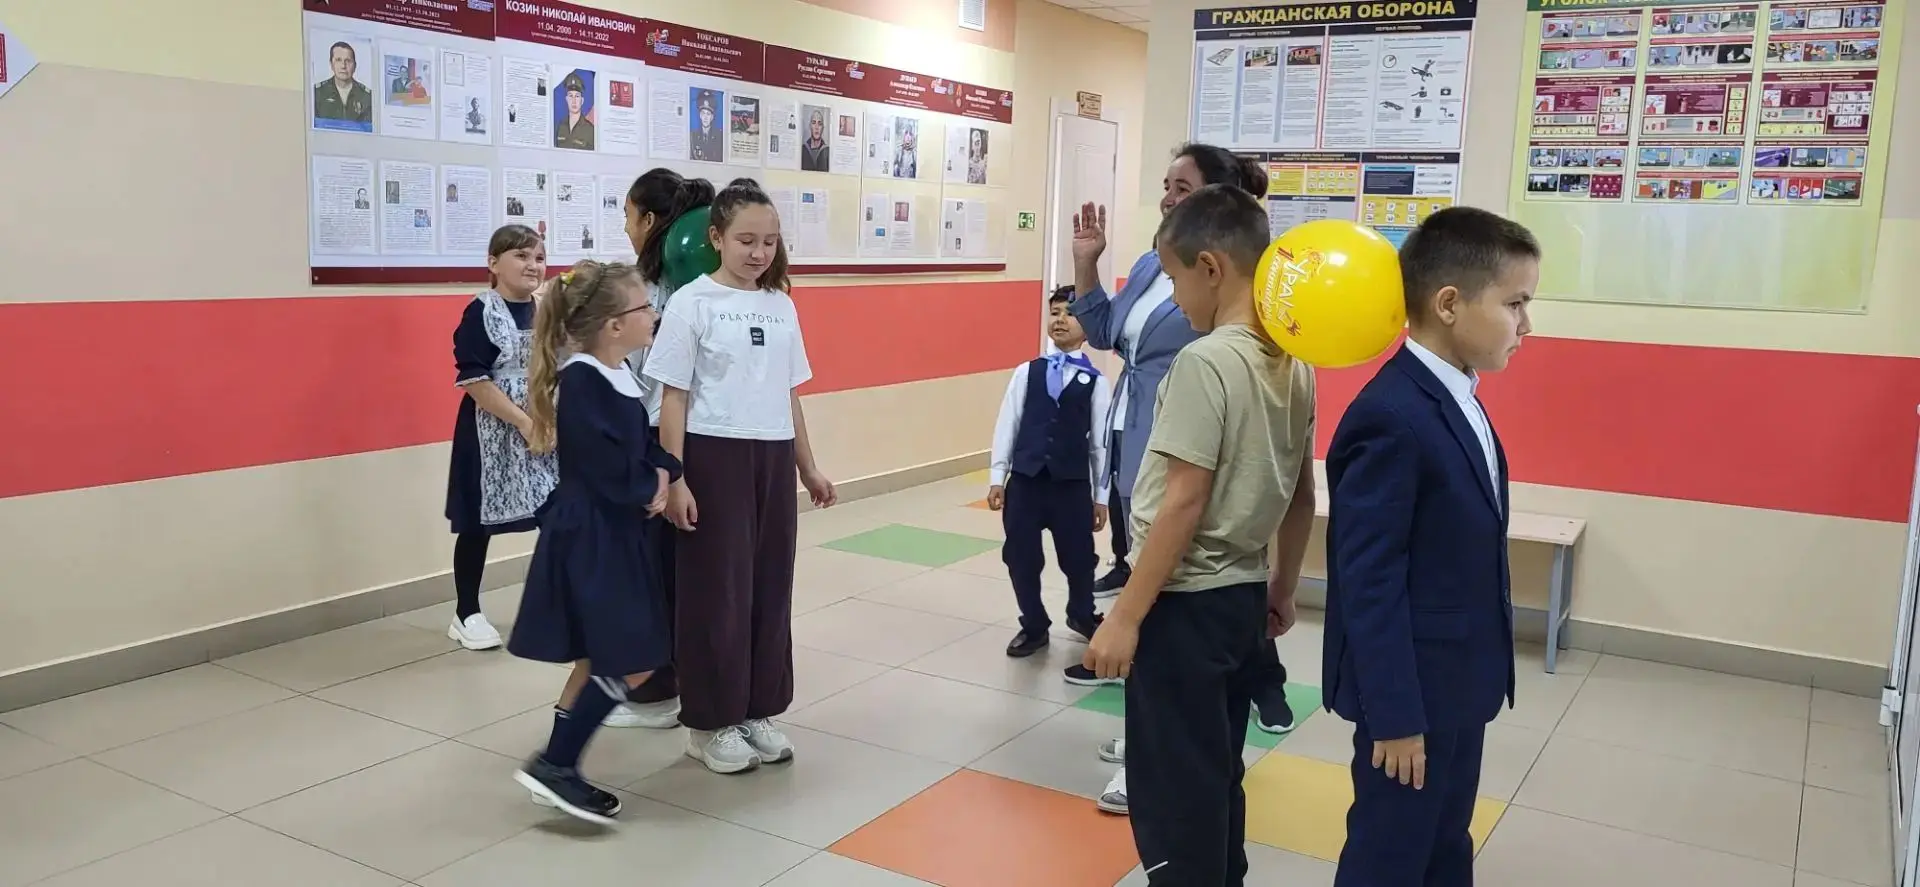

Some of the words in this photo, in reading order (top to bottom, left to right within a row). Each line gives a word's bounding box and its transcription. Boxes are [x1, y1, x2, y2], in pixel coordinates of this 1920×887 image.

[505, 0, 540, 15] КОЗИН
[542, 5, 586, 25] НИКОЛАЙ
[588, 14, 636, 34] ИВАНОВИЧ
[1211, 5, 1352, 25] ГРАЖДАНСКАЯ
[1357, 0, 1456, 18] ОБОРОНА
[537, 22, 555, 32] 11.04.
[556, 25, 572, 35] 2000
[579, 29, 610, 42] 14.11.2022
